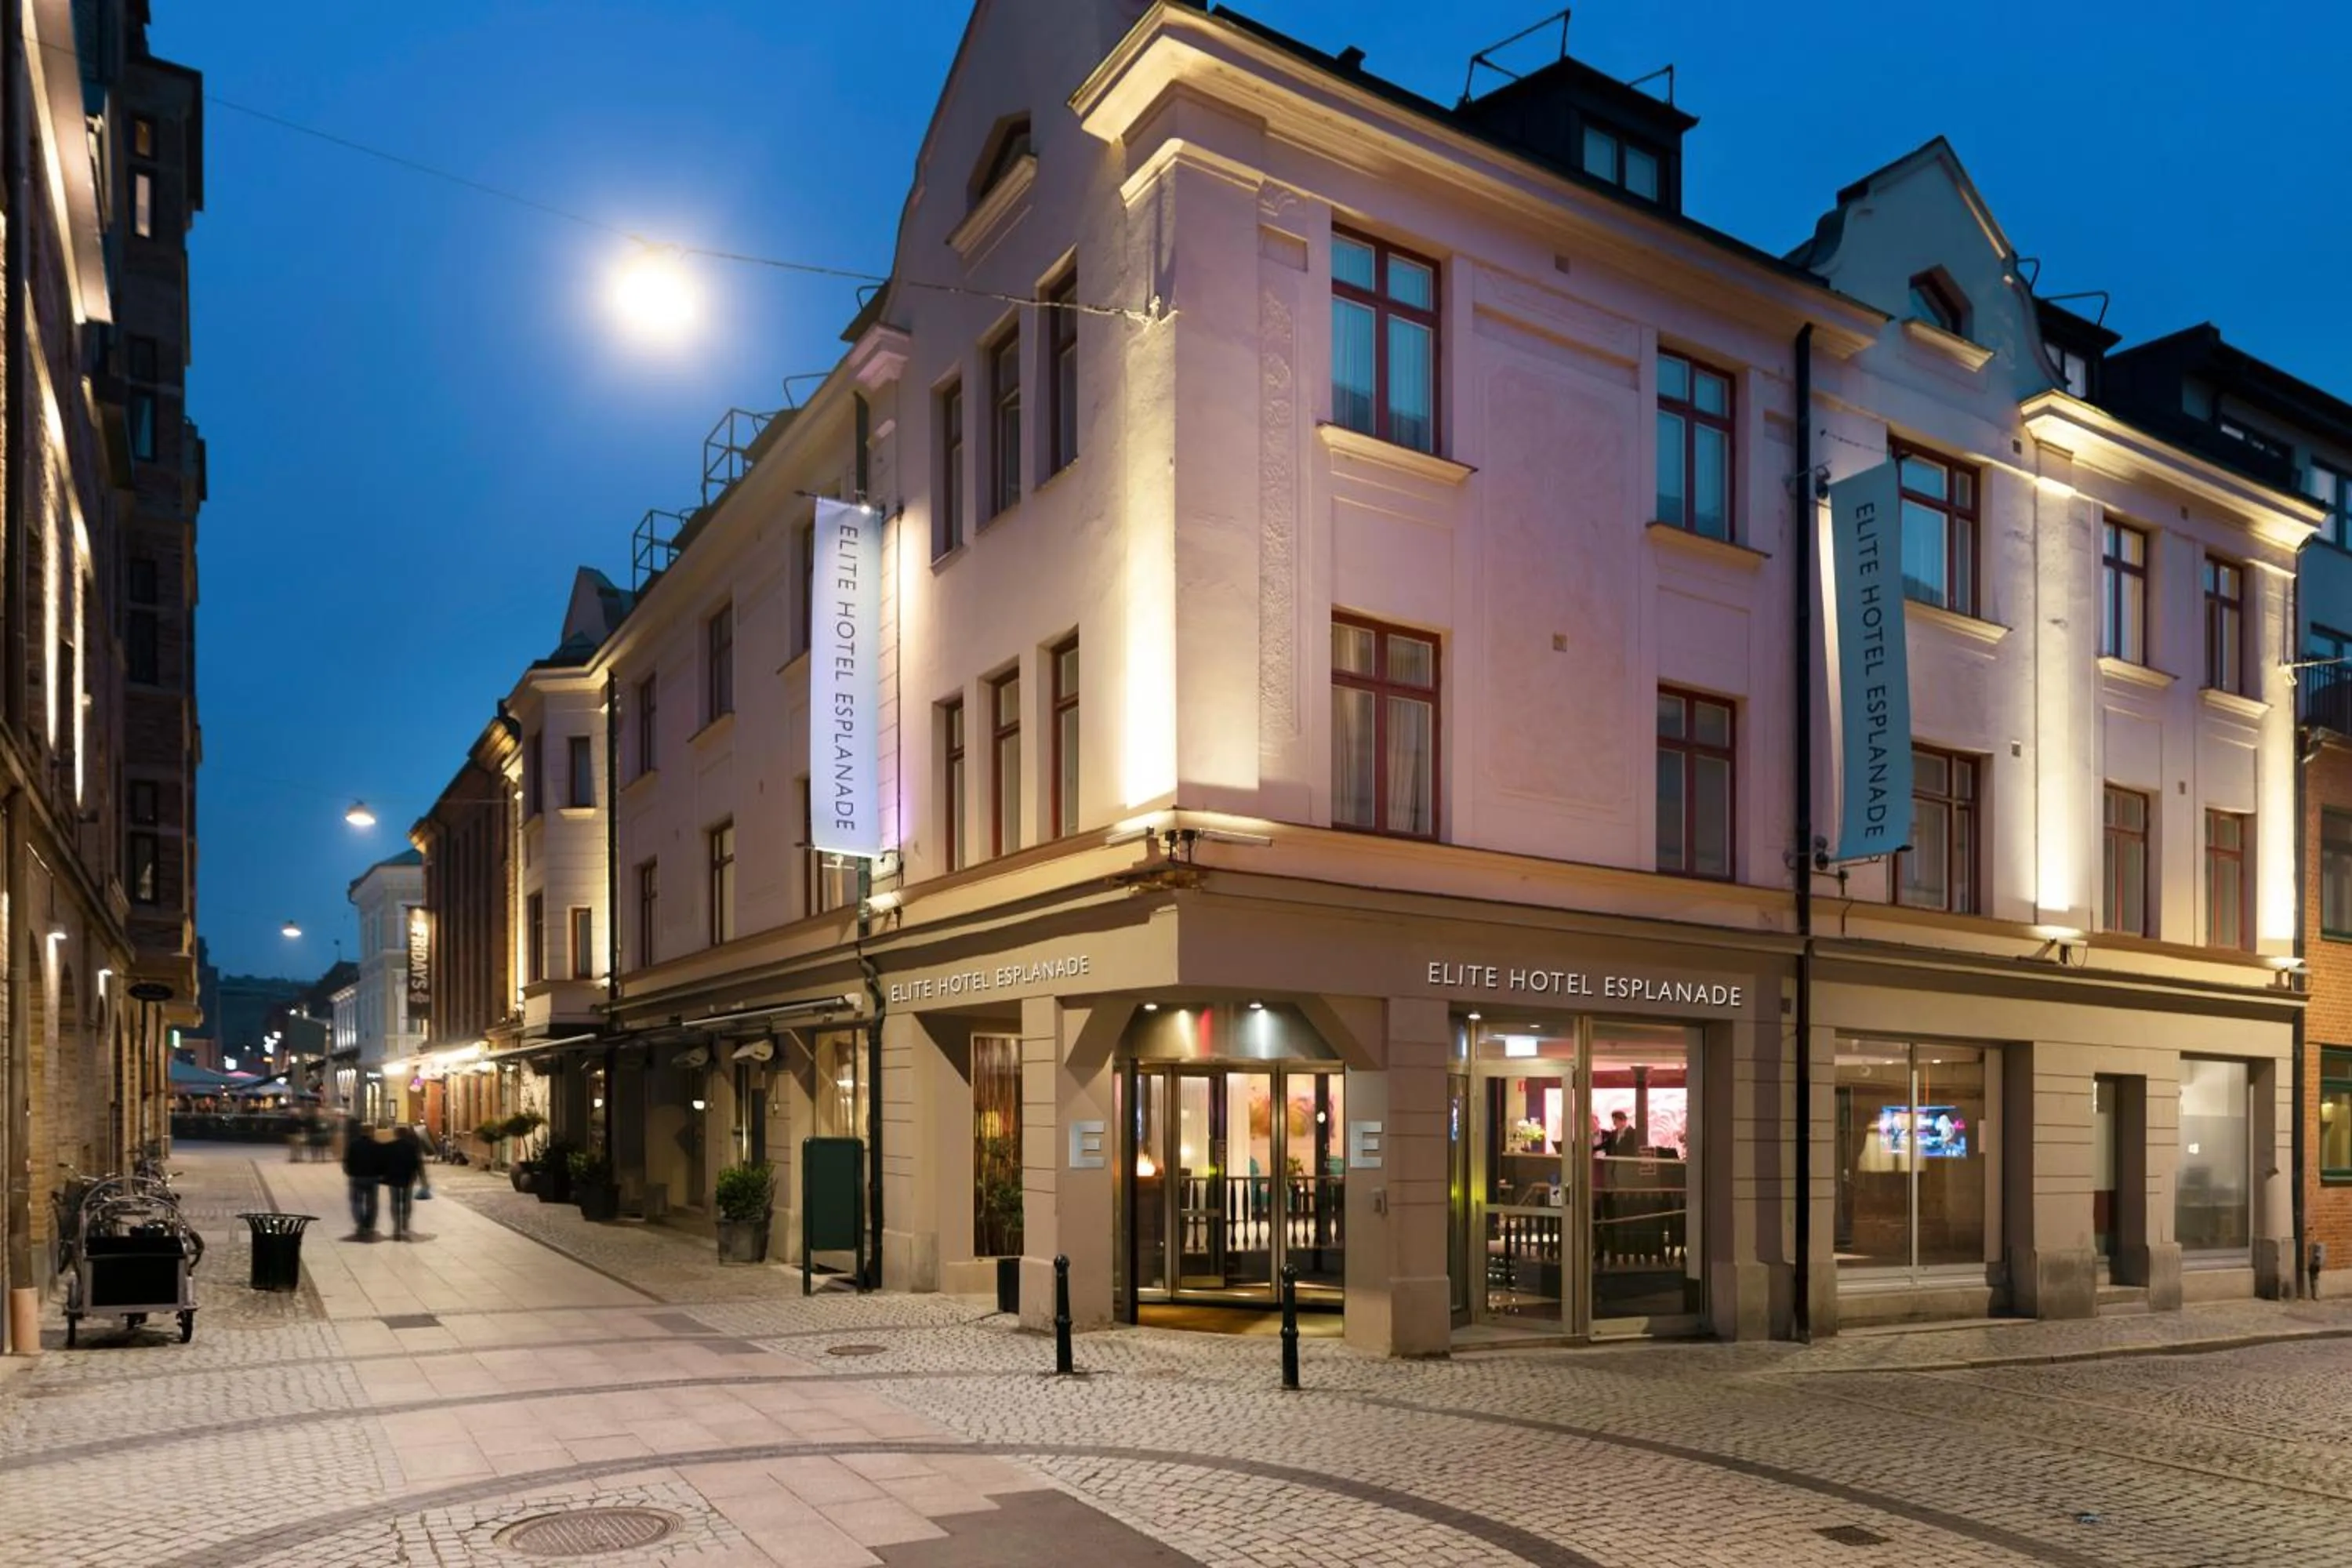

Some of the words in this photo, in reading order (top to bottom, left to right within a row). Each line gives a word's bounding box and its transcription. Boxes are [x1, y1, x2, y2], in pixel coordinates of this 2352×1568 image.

[839, 524, 858, 590] ELITE
[1856, 503, 1878, 575] ELITE
[836, 601, 856, 681] HOTEL
[1861, 588, 1884, 677] HOTEL
[834, 693, 855, 831] ESPLANADE
[1865, 687, 1887, 839] ESPLANADE
[891, 978, 934, 1003] ELITE
[938, 971, 990, 996] HOTEL
[996, 955, 1090, 986] ESPLANADE
[1428, 962, 1498, 988] ELITE
[1509, 969, 1592, 996] HOTEL
[1604, 976, 1742, 1007] ESPLANADE
[1068, 1120, 1105, 1168] E
[1349, 1120, 1383, 1168] E
